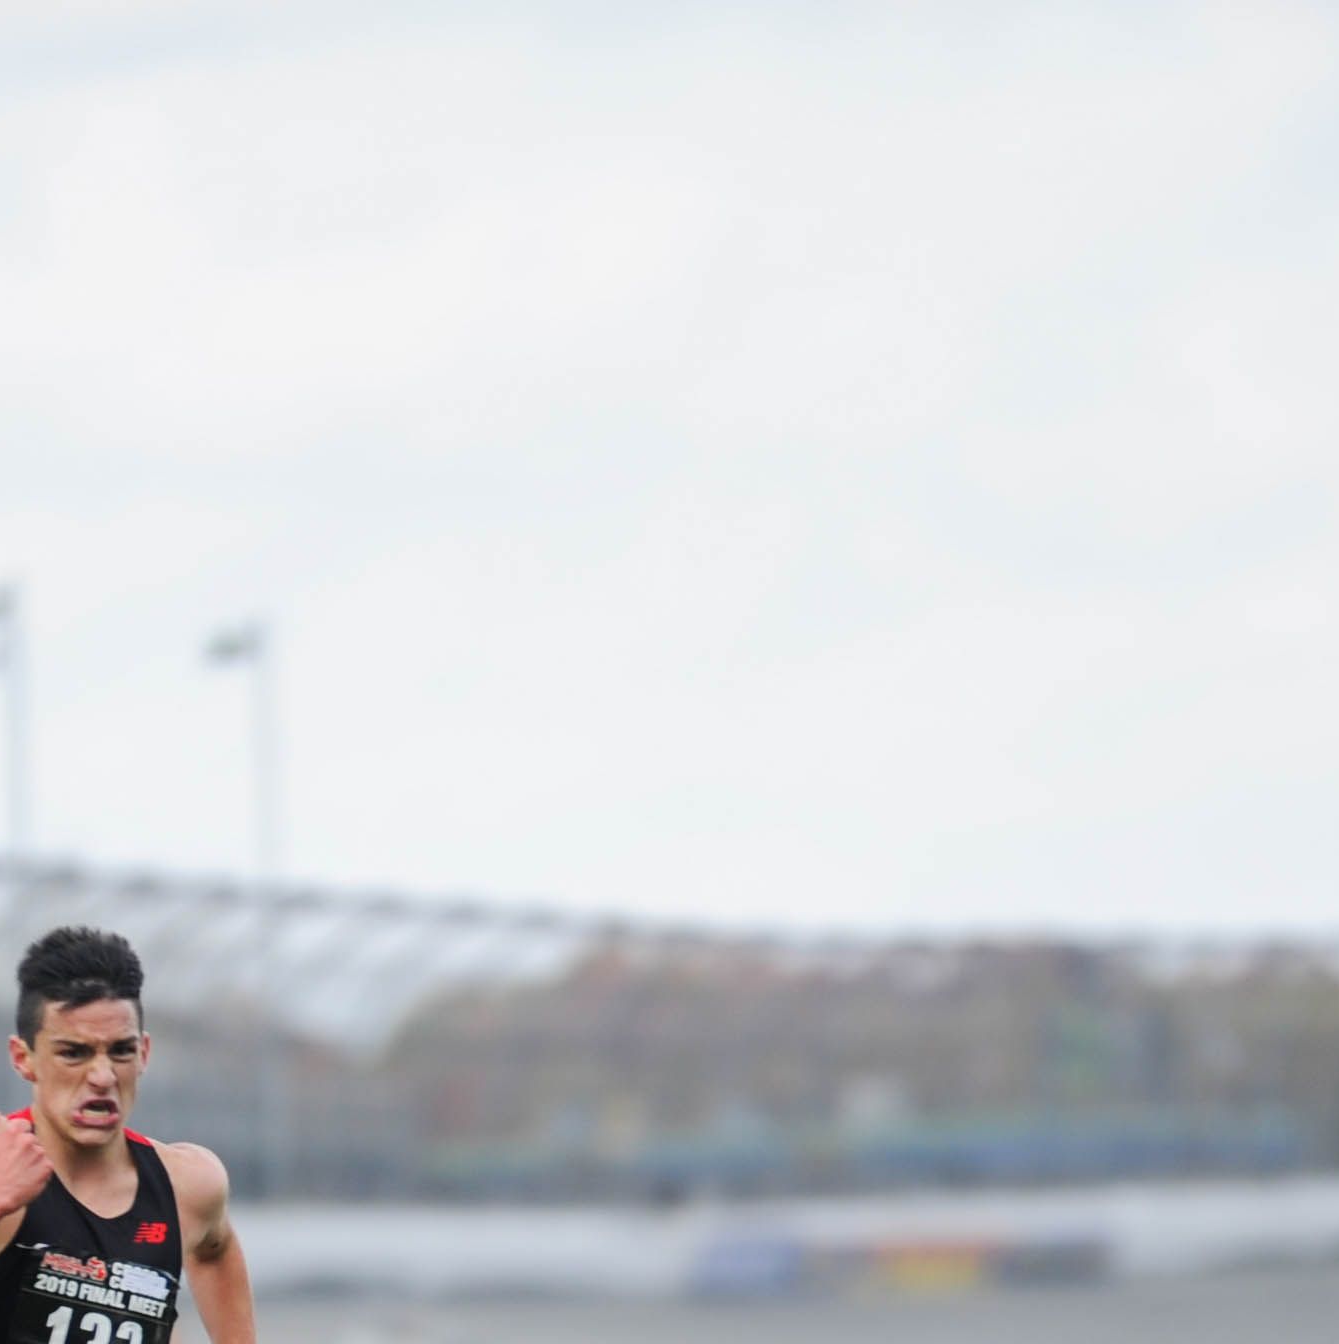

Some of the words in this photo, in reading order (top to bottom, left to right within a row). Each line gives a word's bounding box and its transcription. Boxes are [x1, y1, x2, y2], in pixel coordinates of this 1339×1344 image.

[33, 1273, 79, 1298] 2019
[78, 1283, 126, 1309] FINAL
[128, 1294, 168, 1319] MEET
